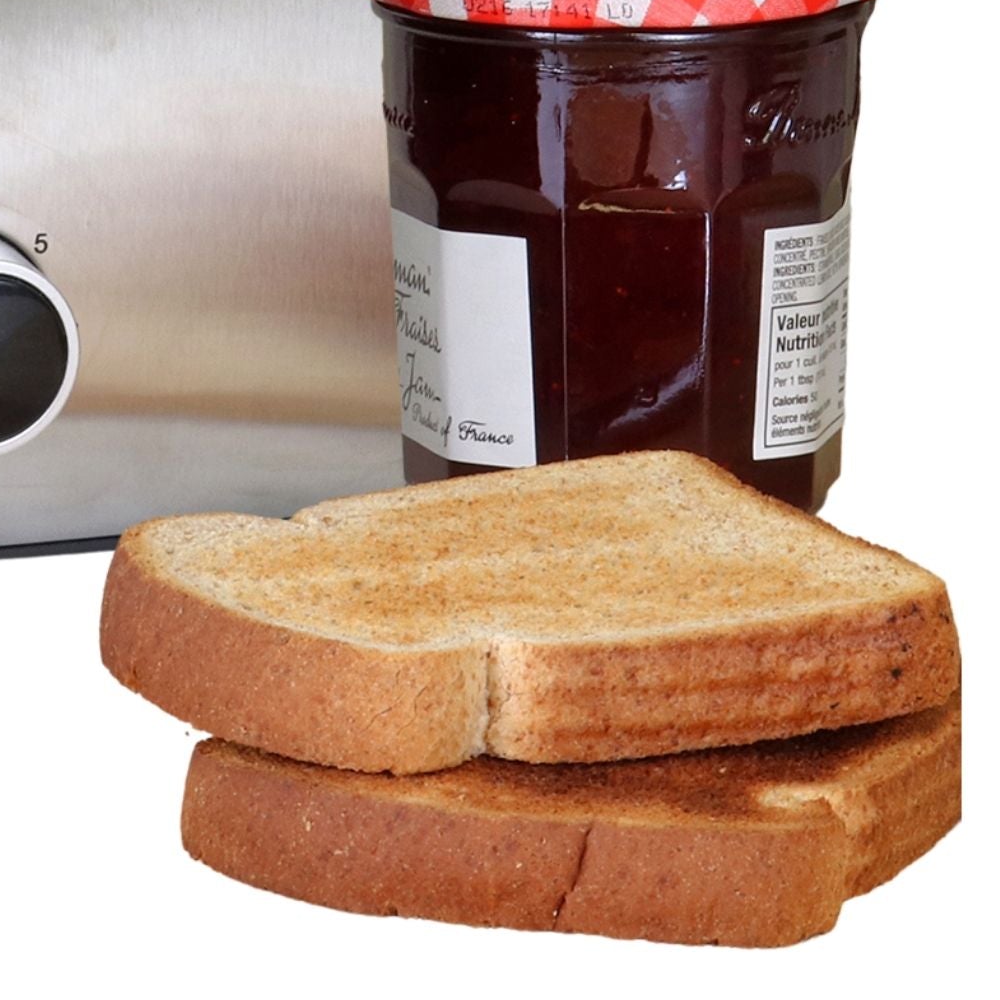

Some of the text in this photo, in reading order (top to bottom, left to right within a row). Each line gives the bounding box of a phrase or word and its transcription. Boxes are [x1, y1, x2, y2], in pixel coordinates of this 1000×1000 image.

[527, 0, 592, 20] 17:41
[33, 233, 49, 254] 5
[777, 313, 821, 332] Valeur
[772, 394, 809, 408] Calories
[458, 420, 514, 445] France
